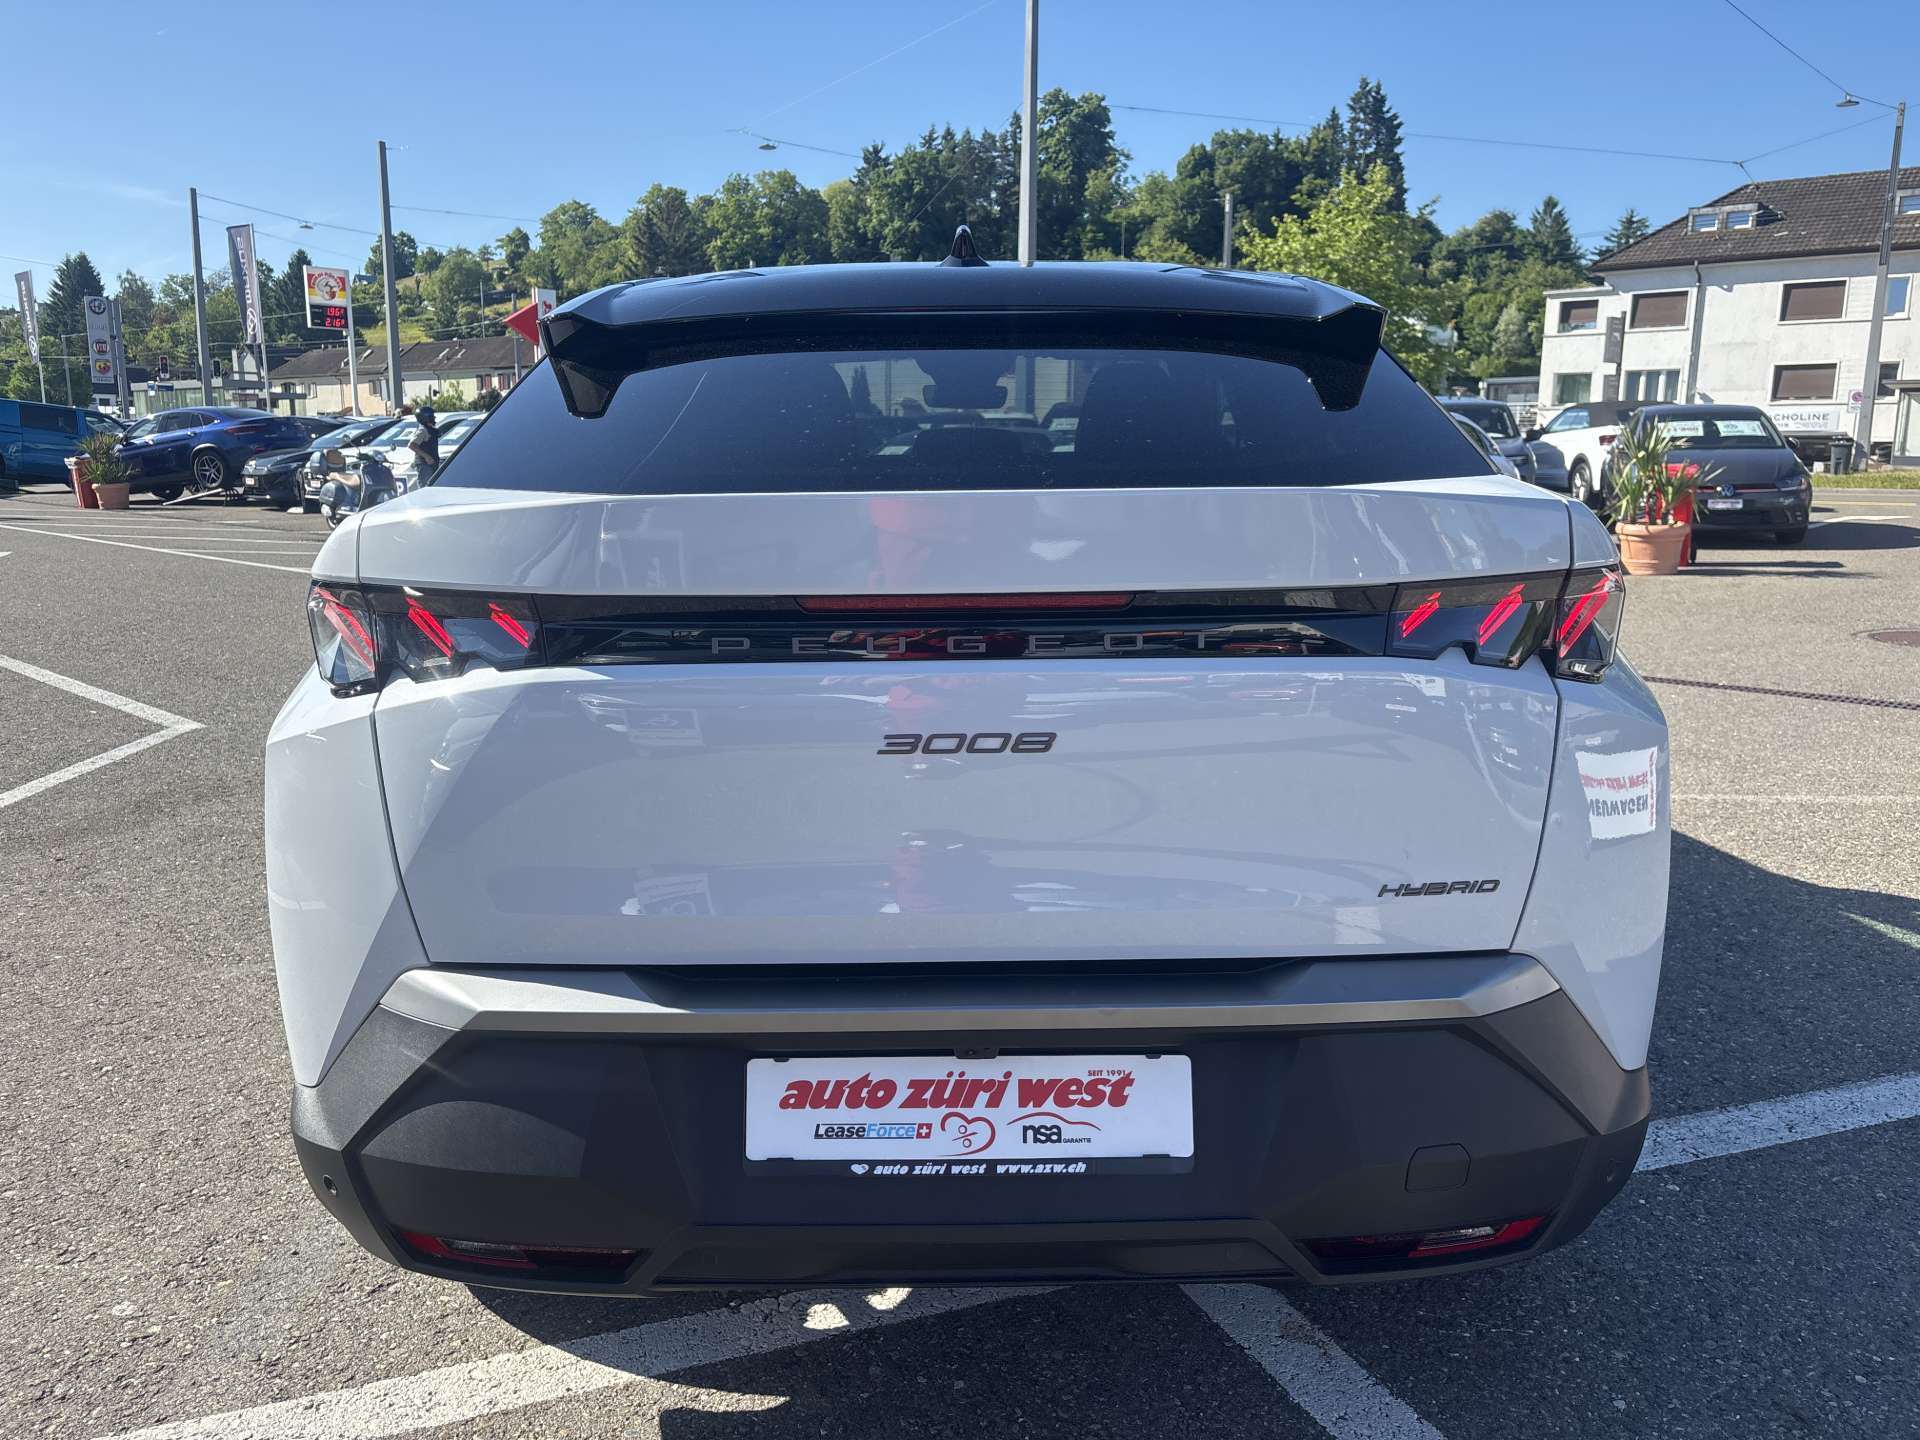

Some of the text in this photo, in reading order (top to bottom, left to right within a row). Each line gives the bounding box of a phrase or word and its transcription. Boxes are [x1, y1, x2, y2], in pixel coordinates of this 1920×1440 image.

[1770, 413, 1830, 421] CHOLINE
[711, 632, 1211, 656] PEUGEOT
[876, 732, 1058, 755] 3008
[1377, 879, 1501, 898] HYBRID
[1087, 1069, 1126, 1077] SEIT 1991
[778, 1070, 1136, 1110] auto züri west
[814, 1123, 917, 1139] LeaseForce
[1022, 1124, 1063, 1144] nsa
[873, 1161, 1087, 1175] auto züri west www.azw.ch
